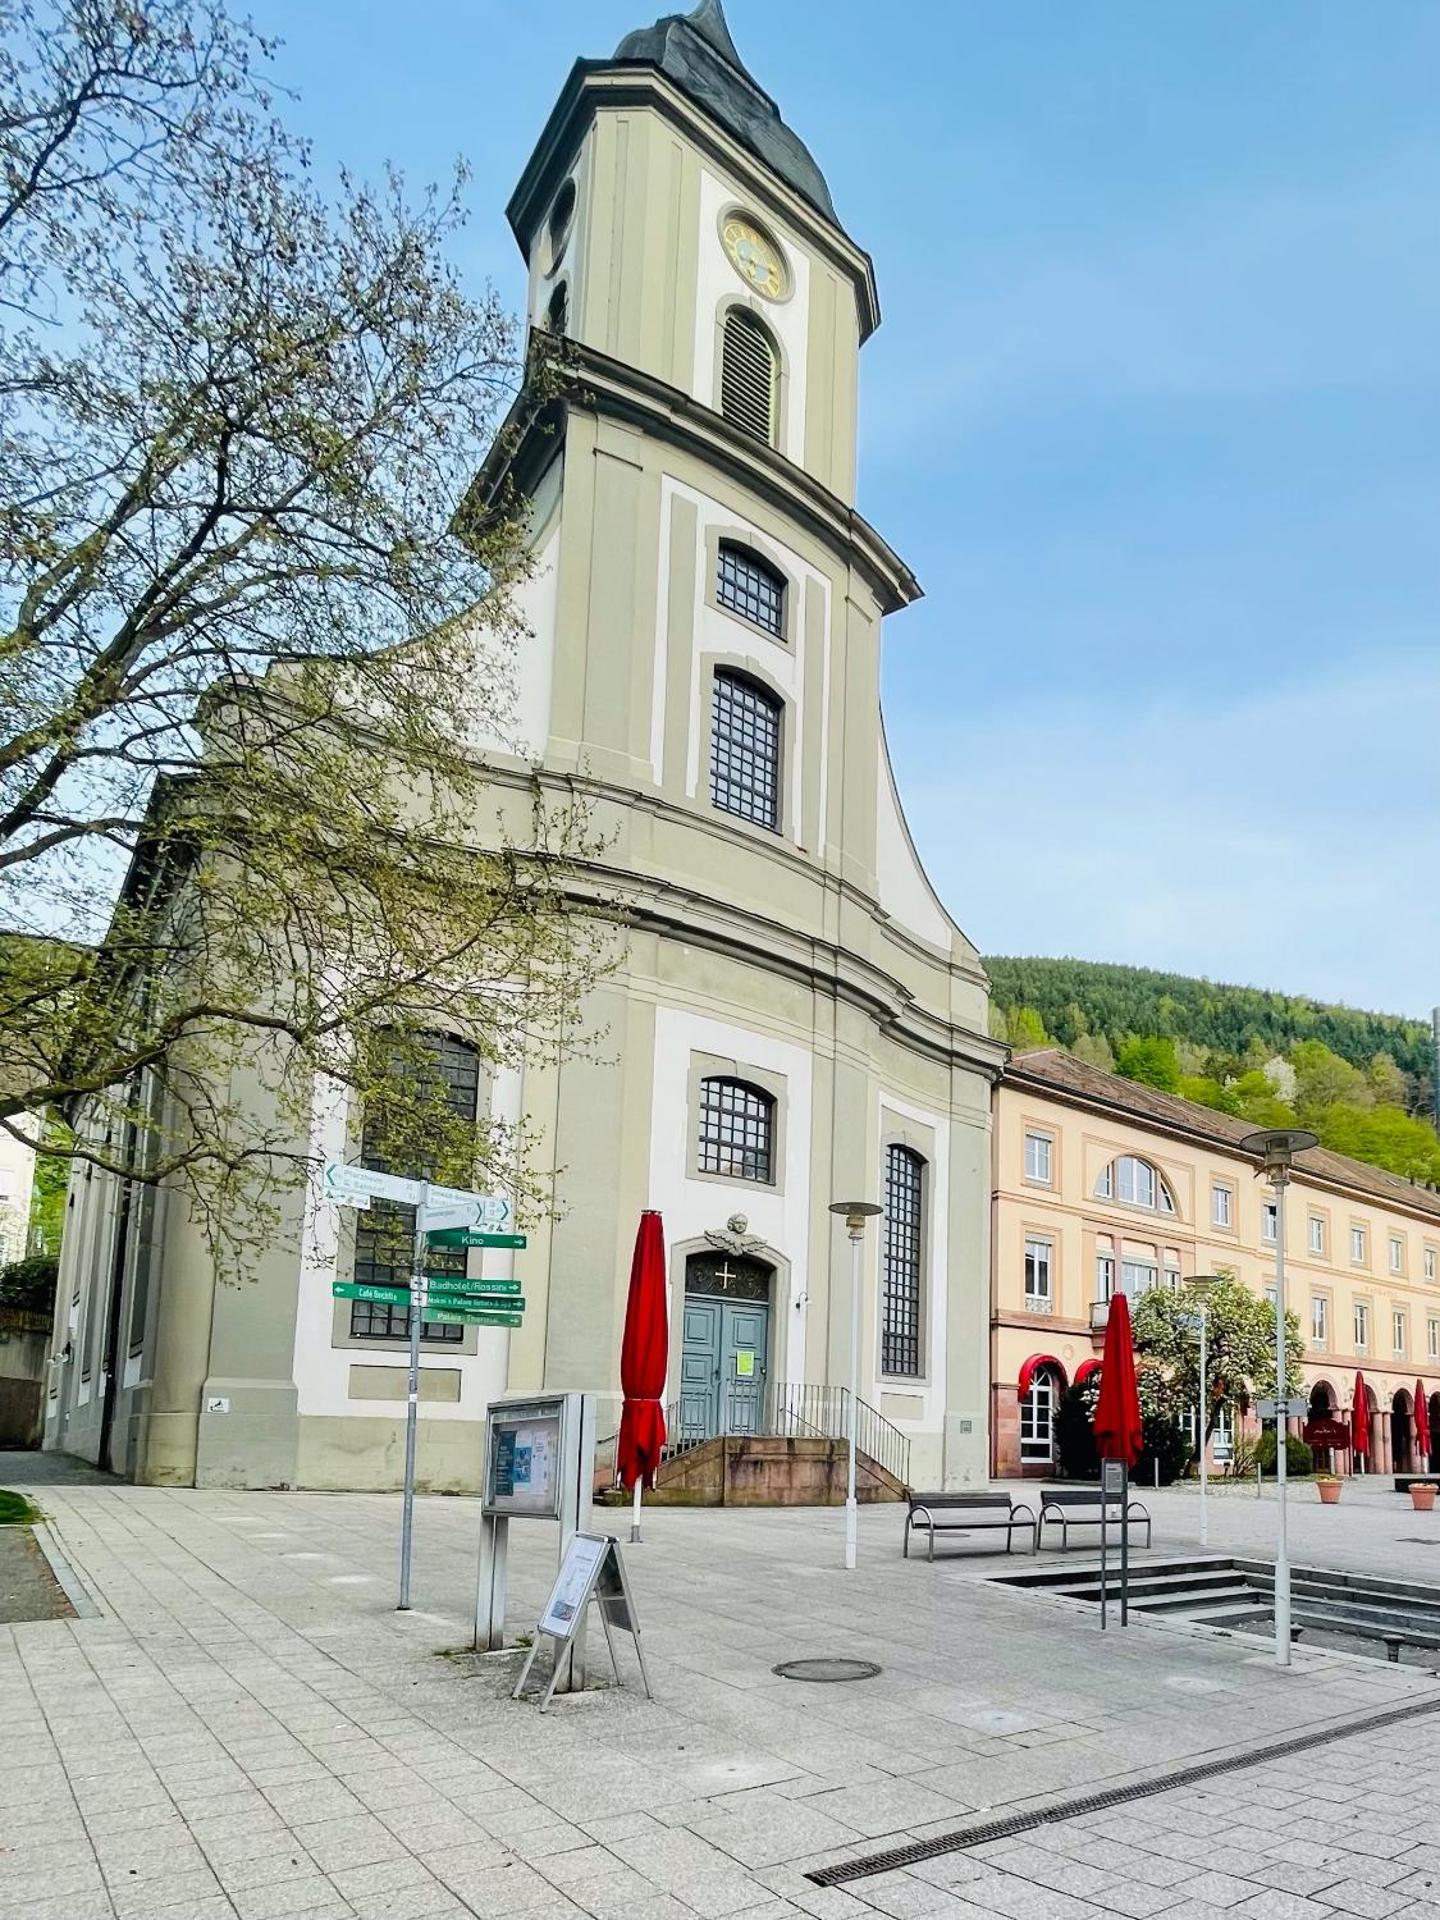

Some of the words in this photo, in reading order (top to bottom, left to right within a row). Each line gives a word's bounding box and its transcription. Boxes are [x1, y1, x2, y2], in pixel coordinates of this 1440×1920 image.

[461, 1236, 484, 1245] Kino
[430, 1281, 507, 1291] Badhotel/Rossini
[358, 1287, 373, 1299] Café
